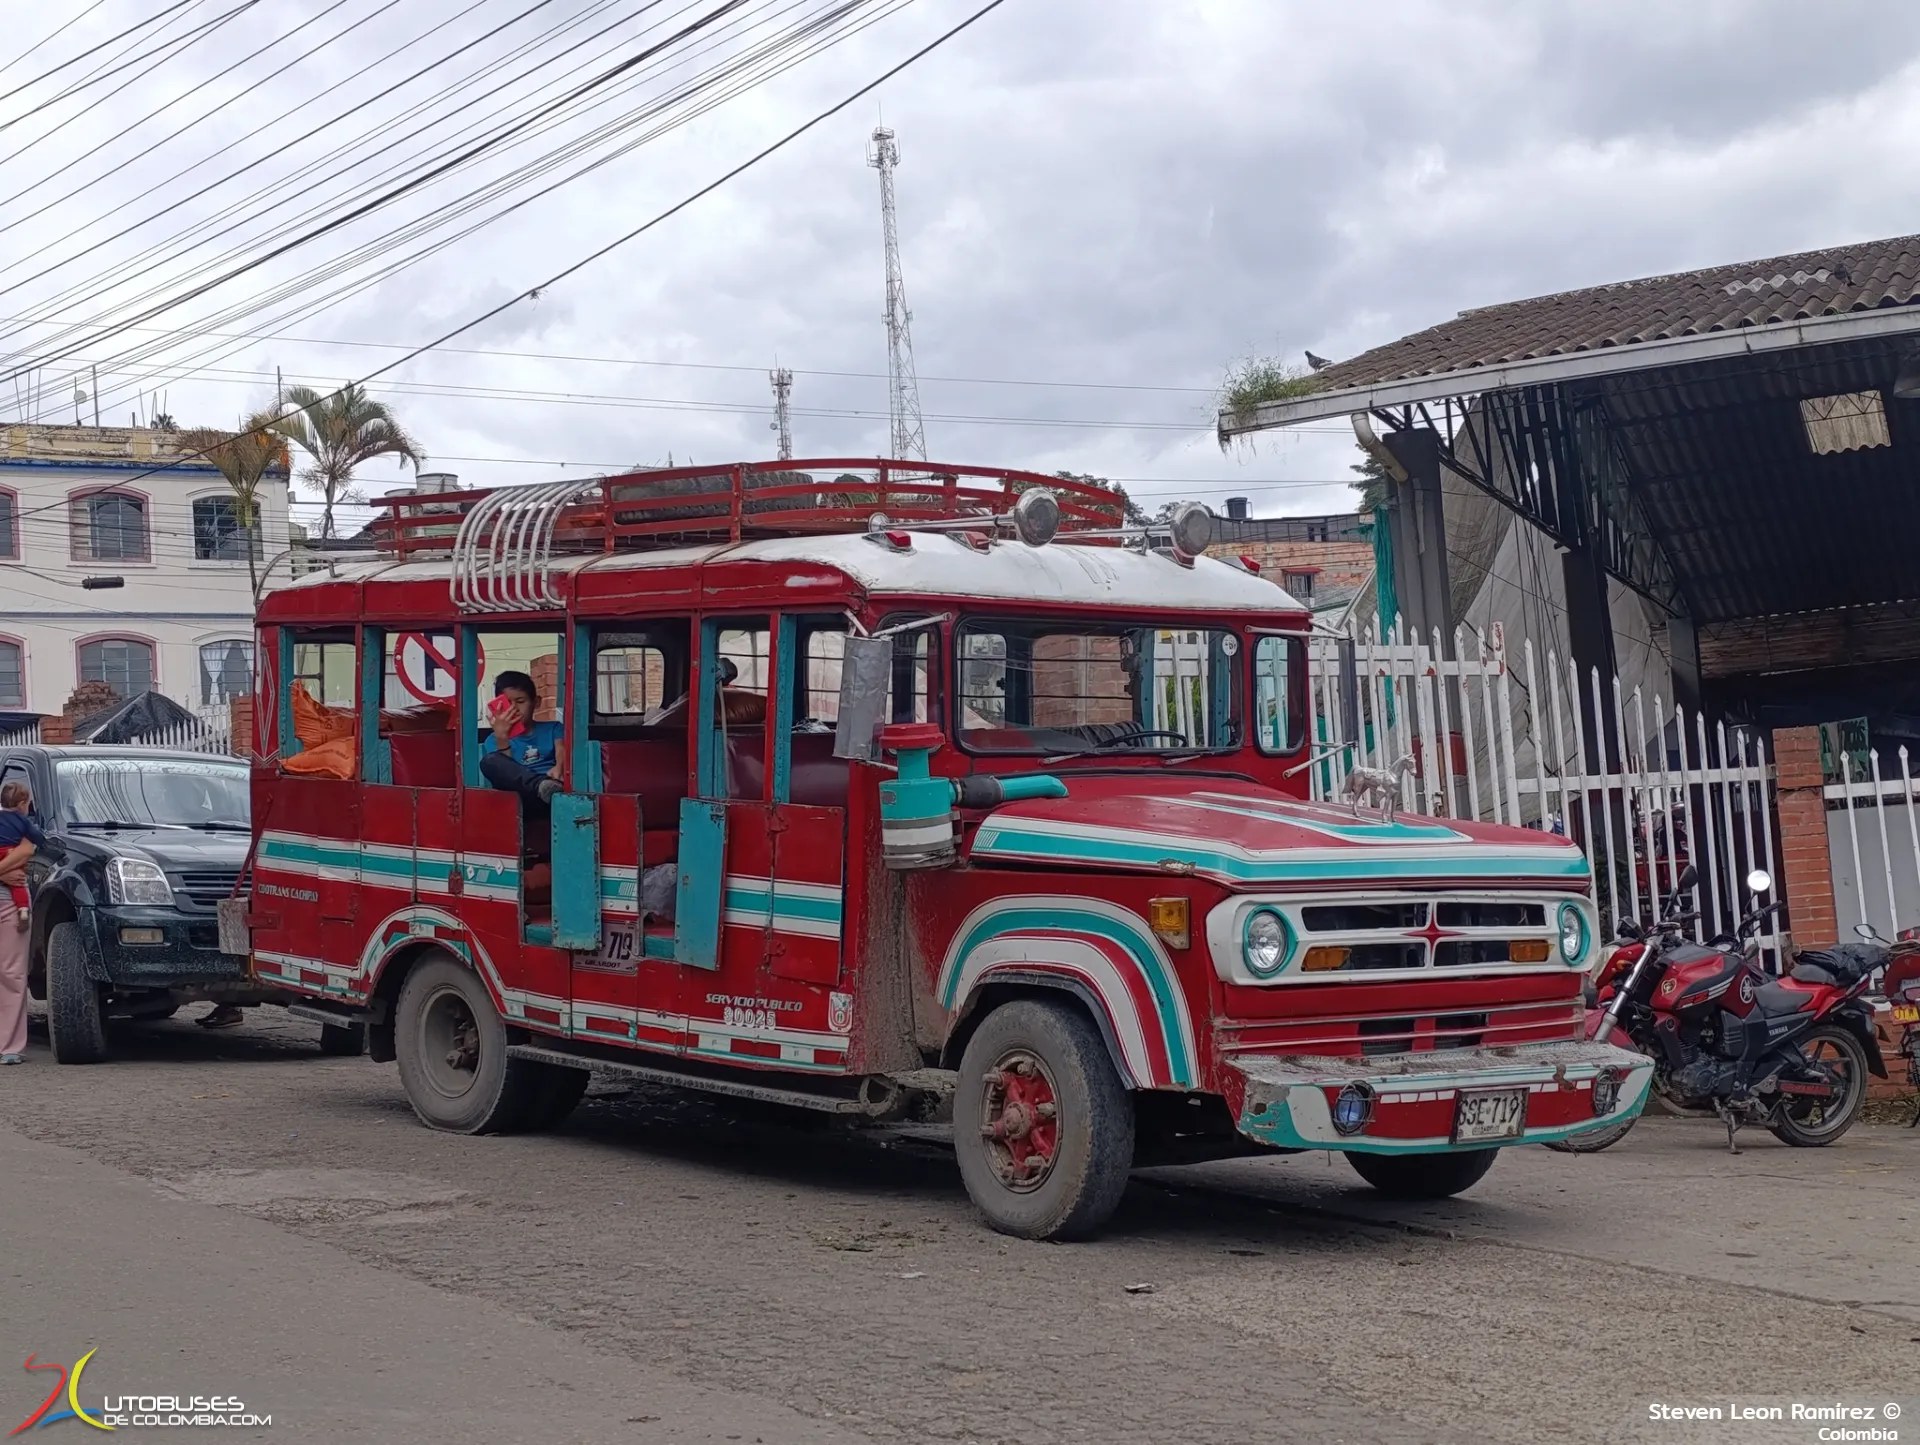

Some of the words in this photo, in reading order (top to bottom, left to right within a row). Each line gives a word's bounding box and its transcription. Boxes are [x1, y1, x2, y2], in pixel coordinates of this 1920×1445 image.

[608, 931, 633, 960] 719
[705, 993, 755, 1007] SERVICIO
[755, 998, 803, 1012] PUBLICO
[1769, 1025, 1788, 1036] YAMAHA
